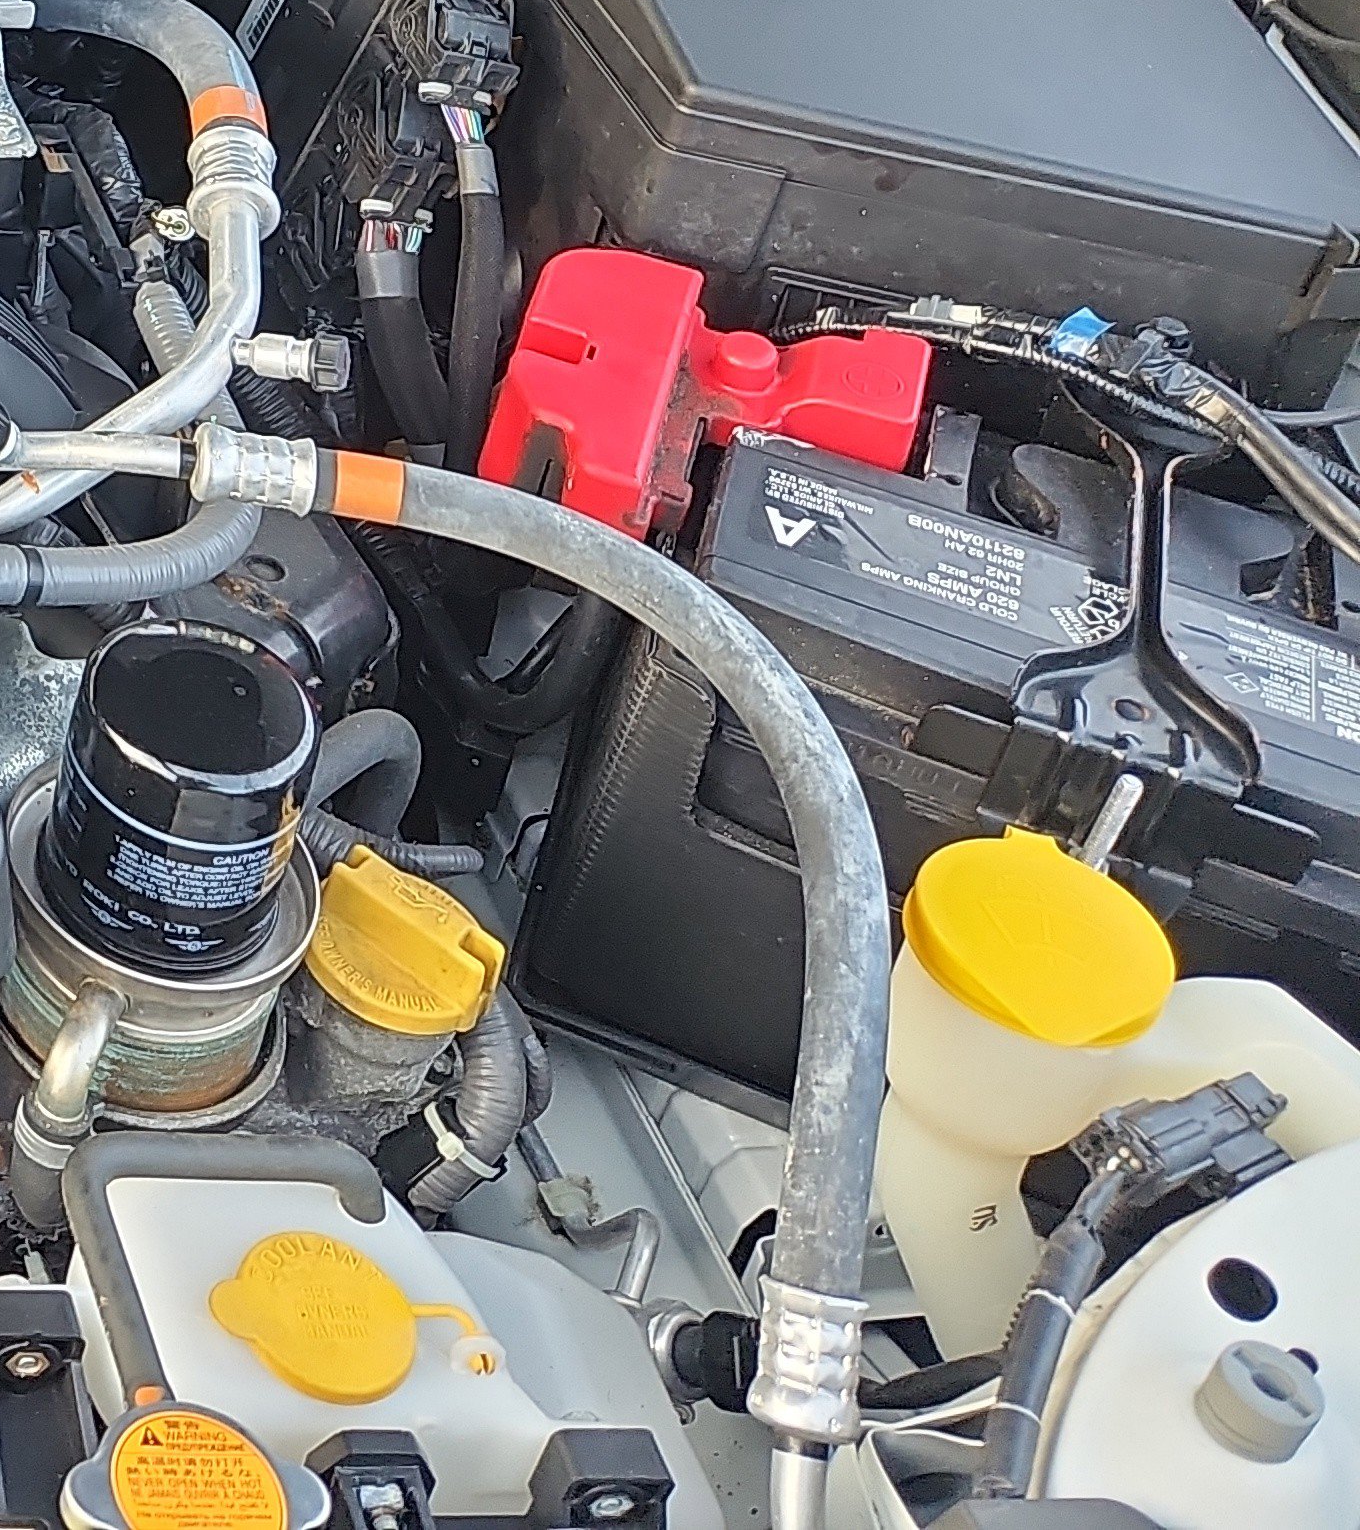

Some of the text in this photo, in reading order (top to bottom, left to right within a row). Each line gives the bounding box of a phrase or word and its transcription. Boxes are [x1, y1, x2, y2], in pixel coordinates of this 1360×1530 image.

[799, 476, 809, 489] IN
[811, 479, 838, 497] MADE
[782, 492, 845, 520] DISTRIBUTED
[907, 514, 1026, 561] 82110AN00B
[944, 539, 966, 554] AH
[927, 571, 981, 600] AMPS
[937, 561, 1021, 597] GROUP SIZE
[984, 564, 1022, 586] LN2
[861, 561, 1019, 621] COLD CRANKING AMPS
[1049, 606, 1085, 645] RETOUR
[213, 847, 271, 866] CAUTION
[83, 878, 120, 912] ROKI
[320, 940, 373, 993] OWNER'S
[373, 985, 442, 1012] MANUAL
[250, 1235, 383, 1283] COOLANT
[164, 1431, 227, 1442] WARNING
